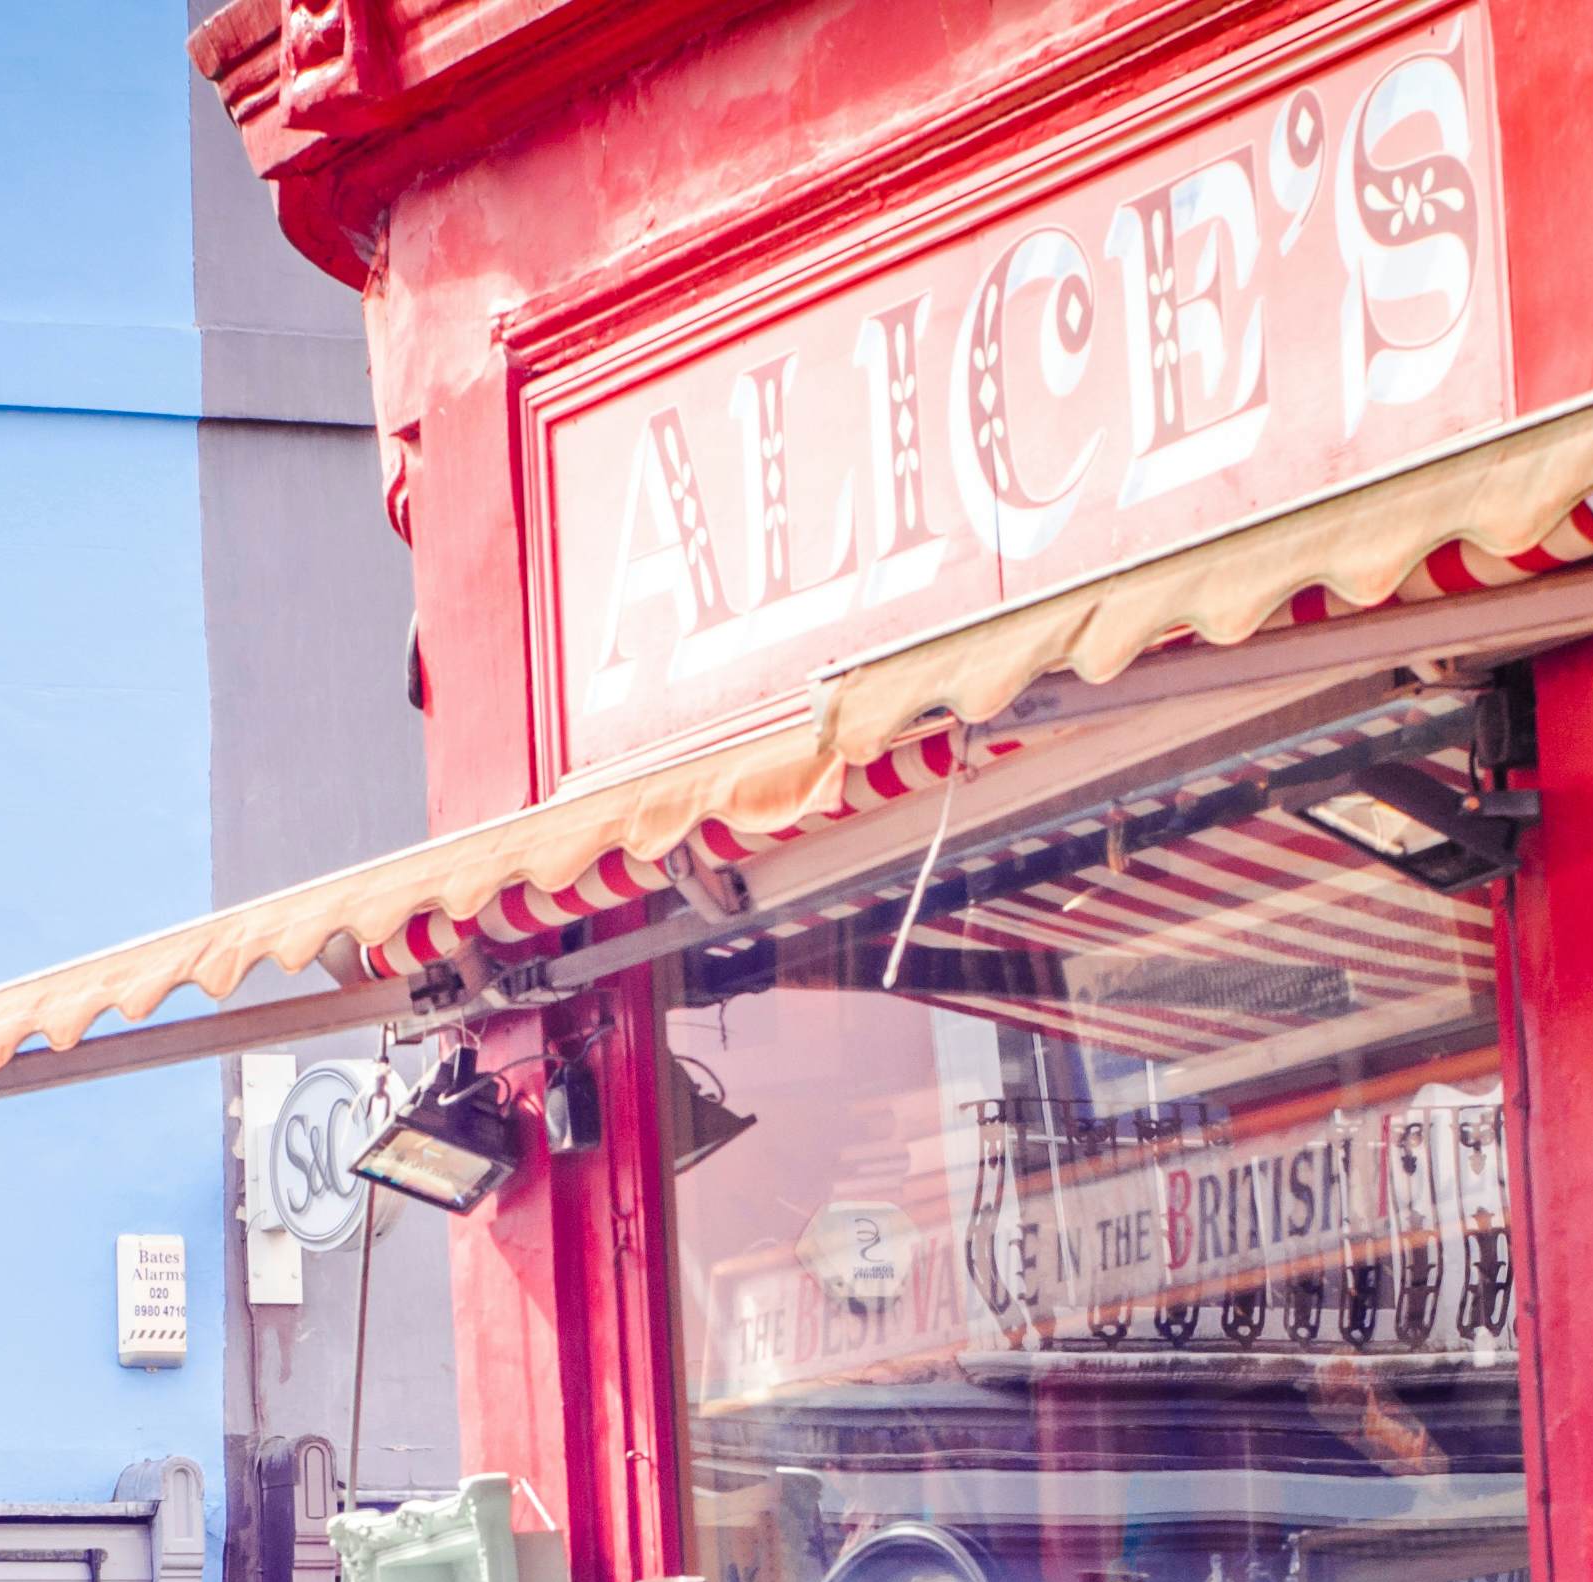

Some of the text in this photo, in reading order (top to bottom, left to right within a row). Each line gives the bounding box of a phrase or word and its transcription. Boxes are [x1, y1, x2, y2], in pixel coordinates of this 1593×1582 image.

[583, 18, 1479, 714] ALICE'S
[1095, 1209, 1153, 1271] THE
[1164, 1138, 1352, 1271] BRITISH
[139, 1249, 180, 1264] Bates
[132, 1267, 186, 1281] Alarms
[149, 1287, 169, 1299] 020
[163, 1305, 187, 1317] 4710
